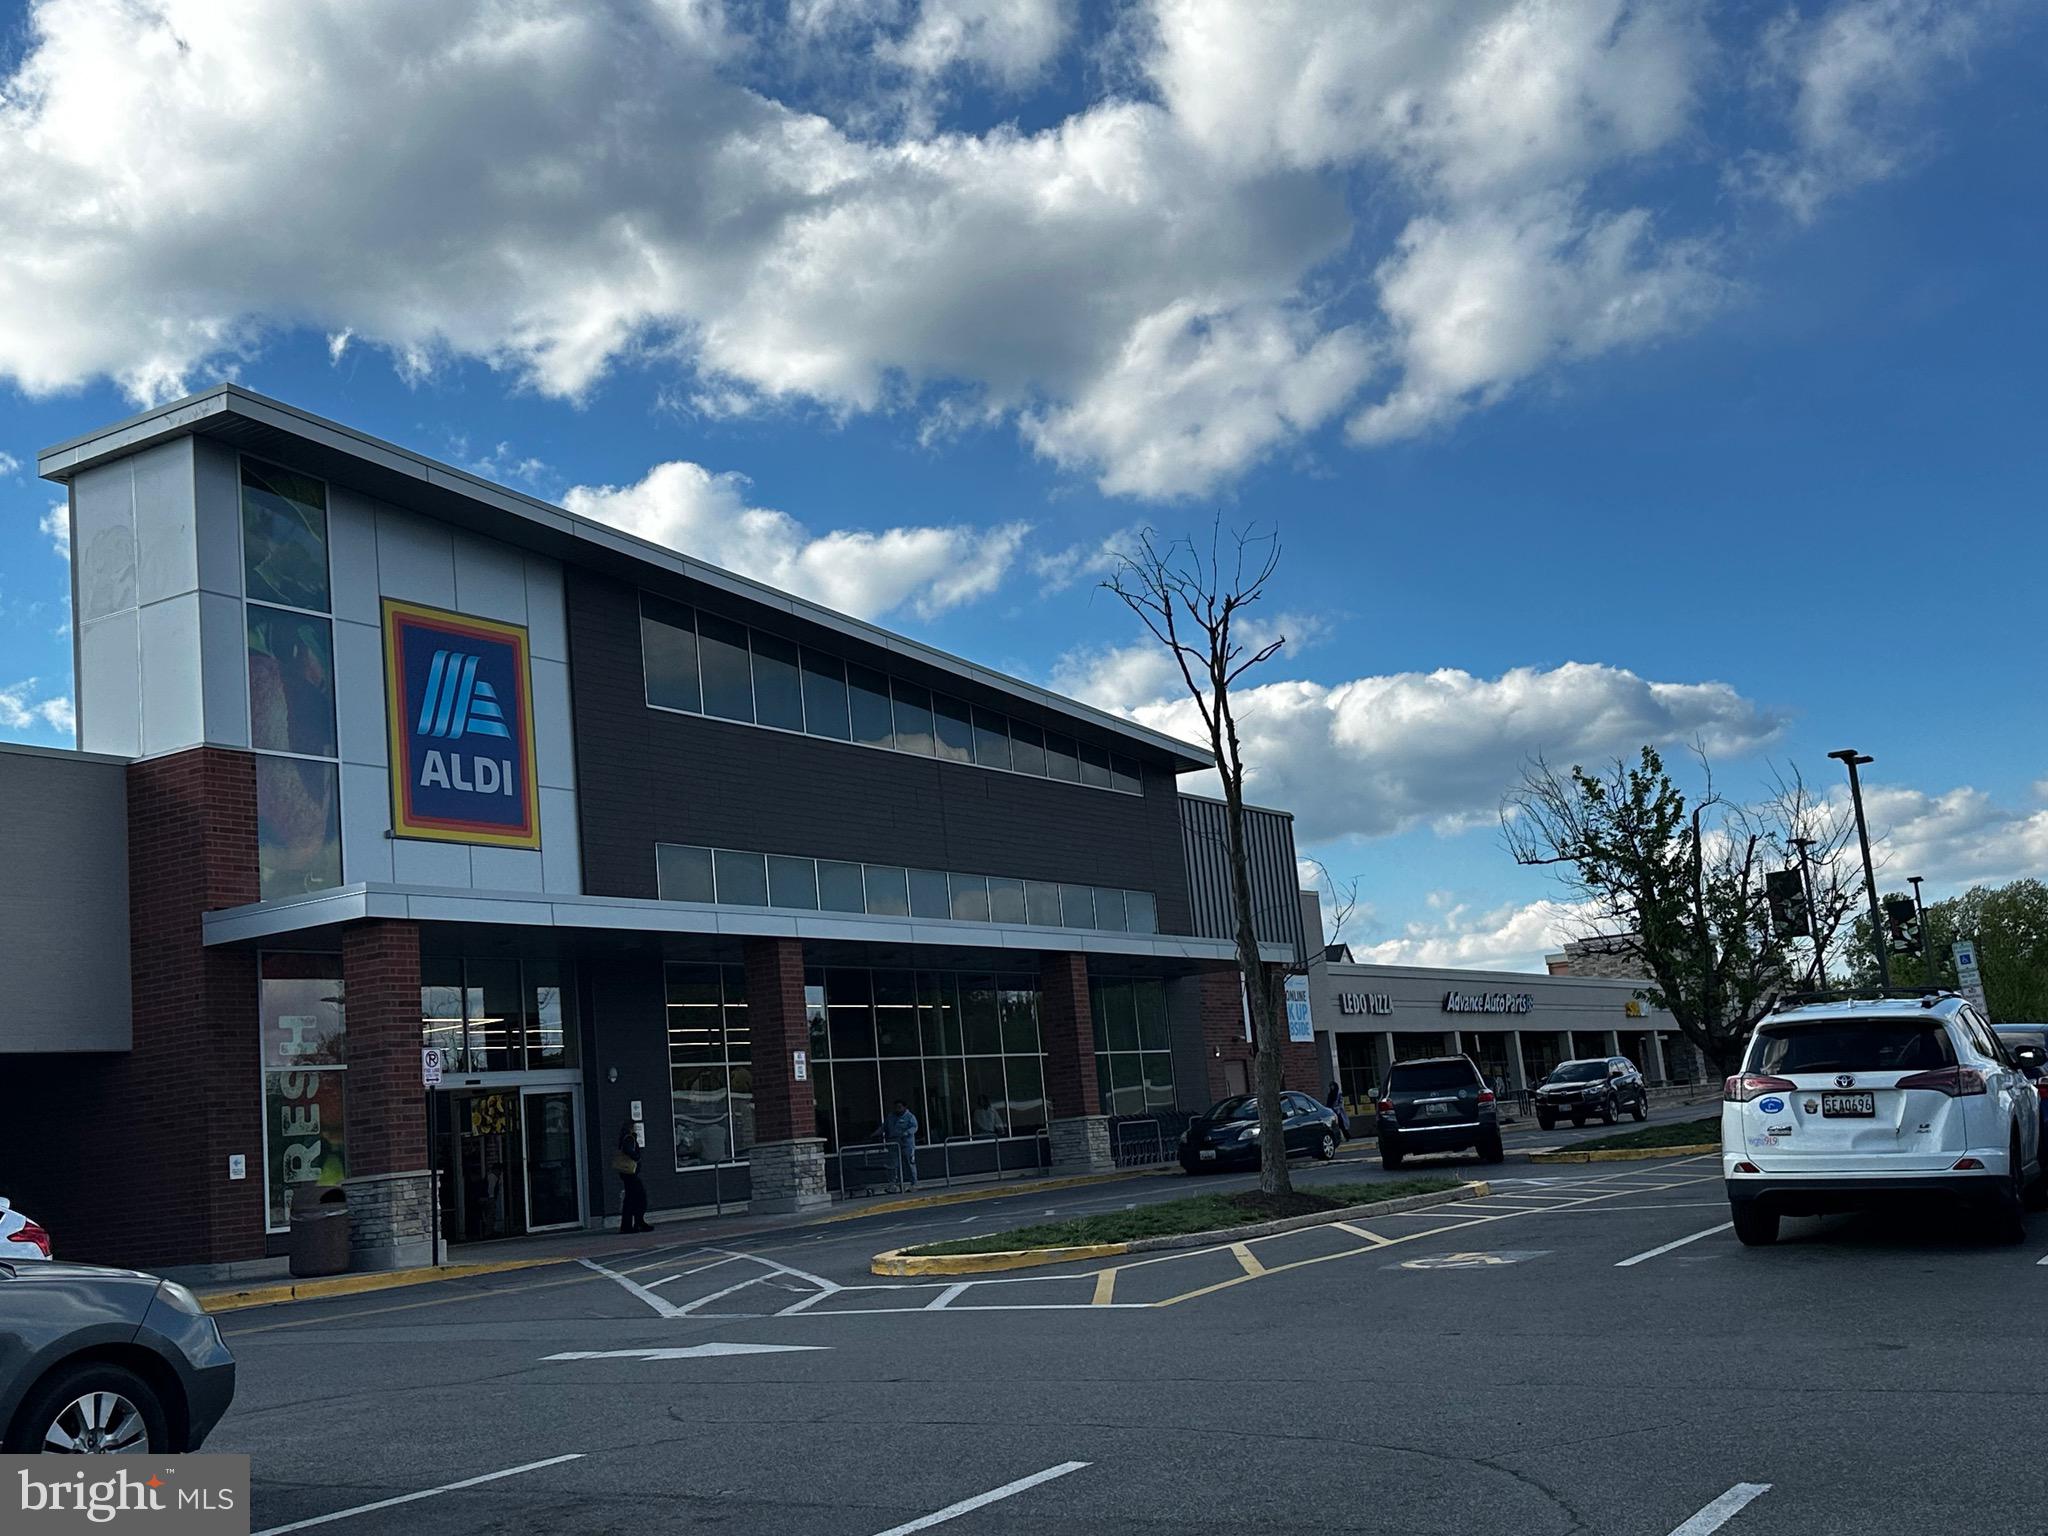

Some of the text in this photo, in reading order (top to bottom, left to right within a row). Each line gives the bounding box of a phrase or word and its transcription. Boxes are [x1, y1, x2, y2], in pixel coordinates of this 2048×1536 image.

[420, 749, 513, 796] ALDI
[1342, 993, 1367, 1014] LEDO
[1446, 992, 1527, 1013] Advance Auto Parts
[1824, 1099, 1872, 1113] 5EA0696
